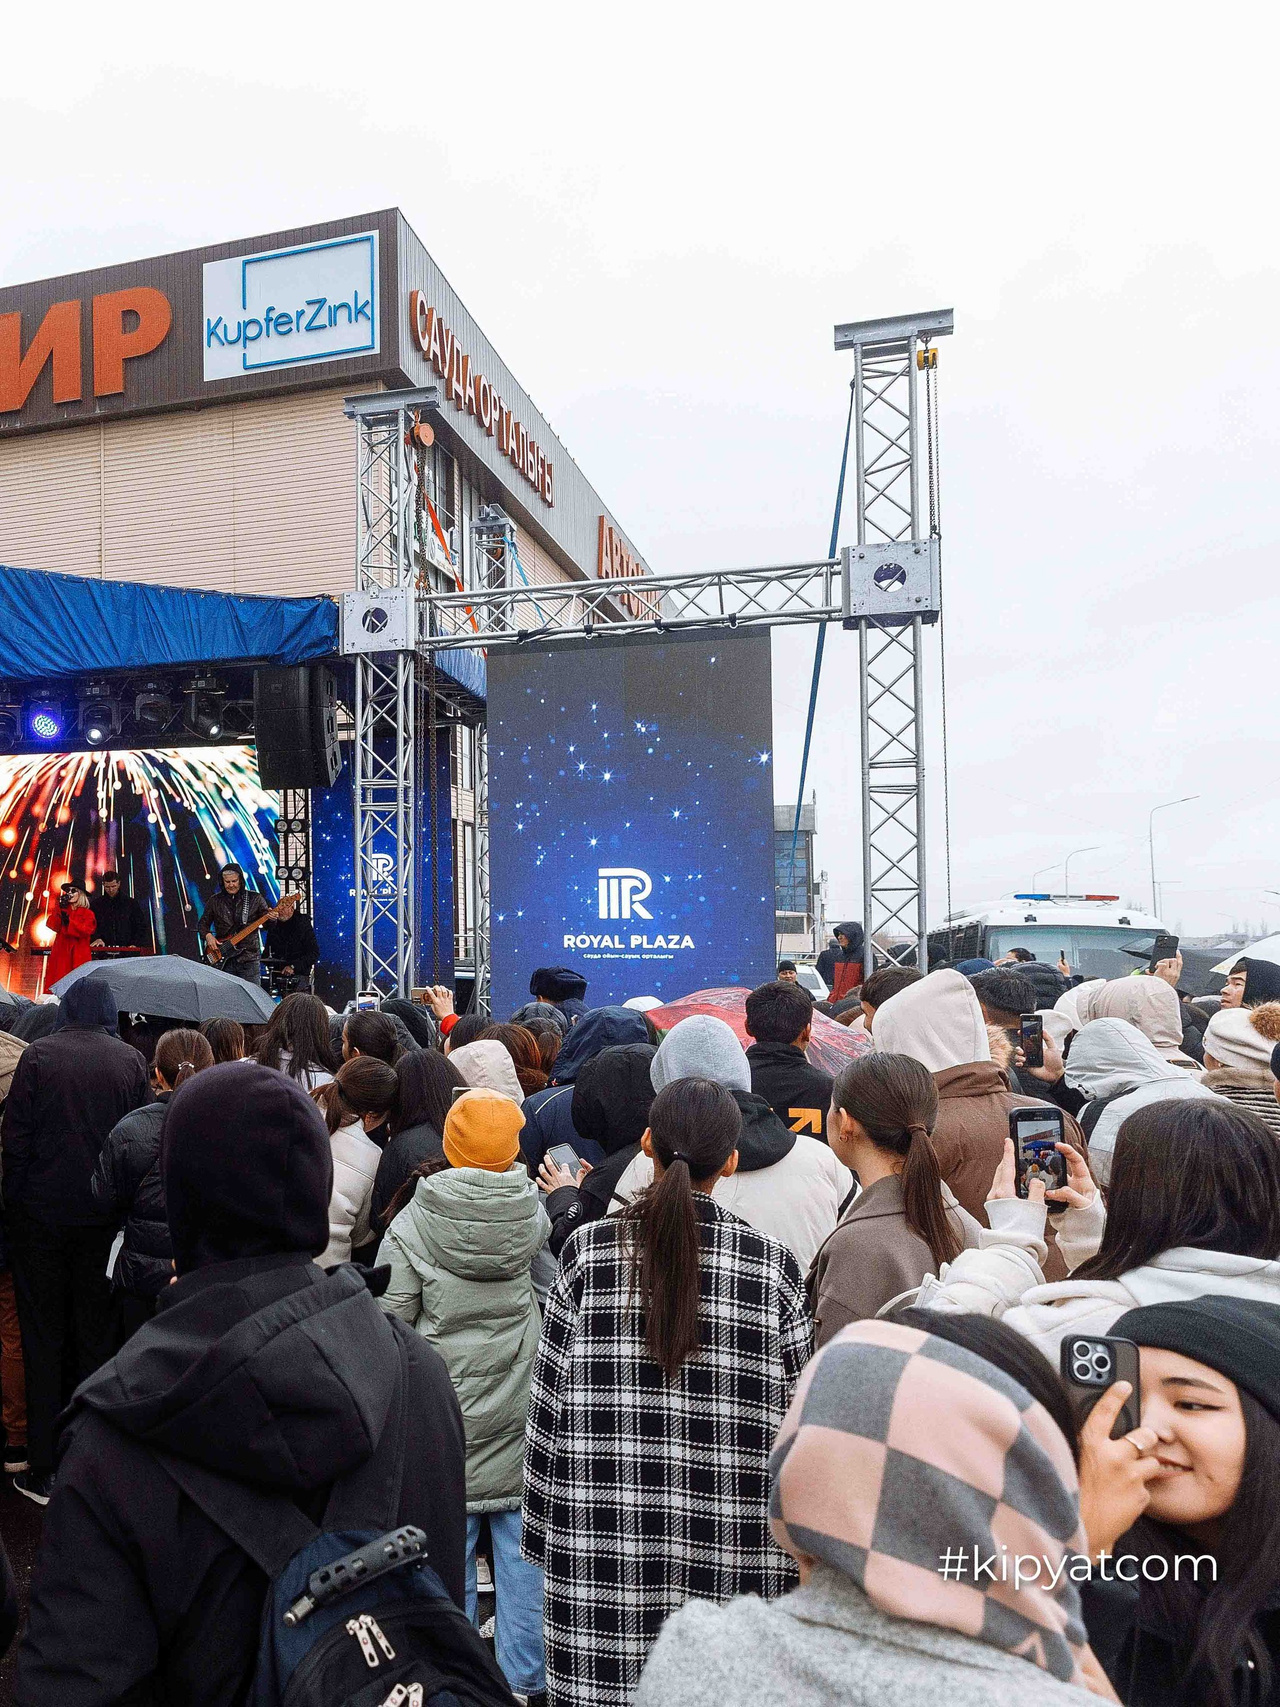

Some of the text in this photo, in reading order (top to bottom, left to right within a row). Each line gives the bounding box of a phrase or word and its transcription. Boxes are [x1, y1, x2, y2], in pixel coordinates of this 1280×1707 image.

[410, 289, 477, 415] САУДА
[563, 934, 695, 949] ROYAL PLAZA
